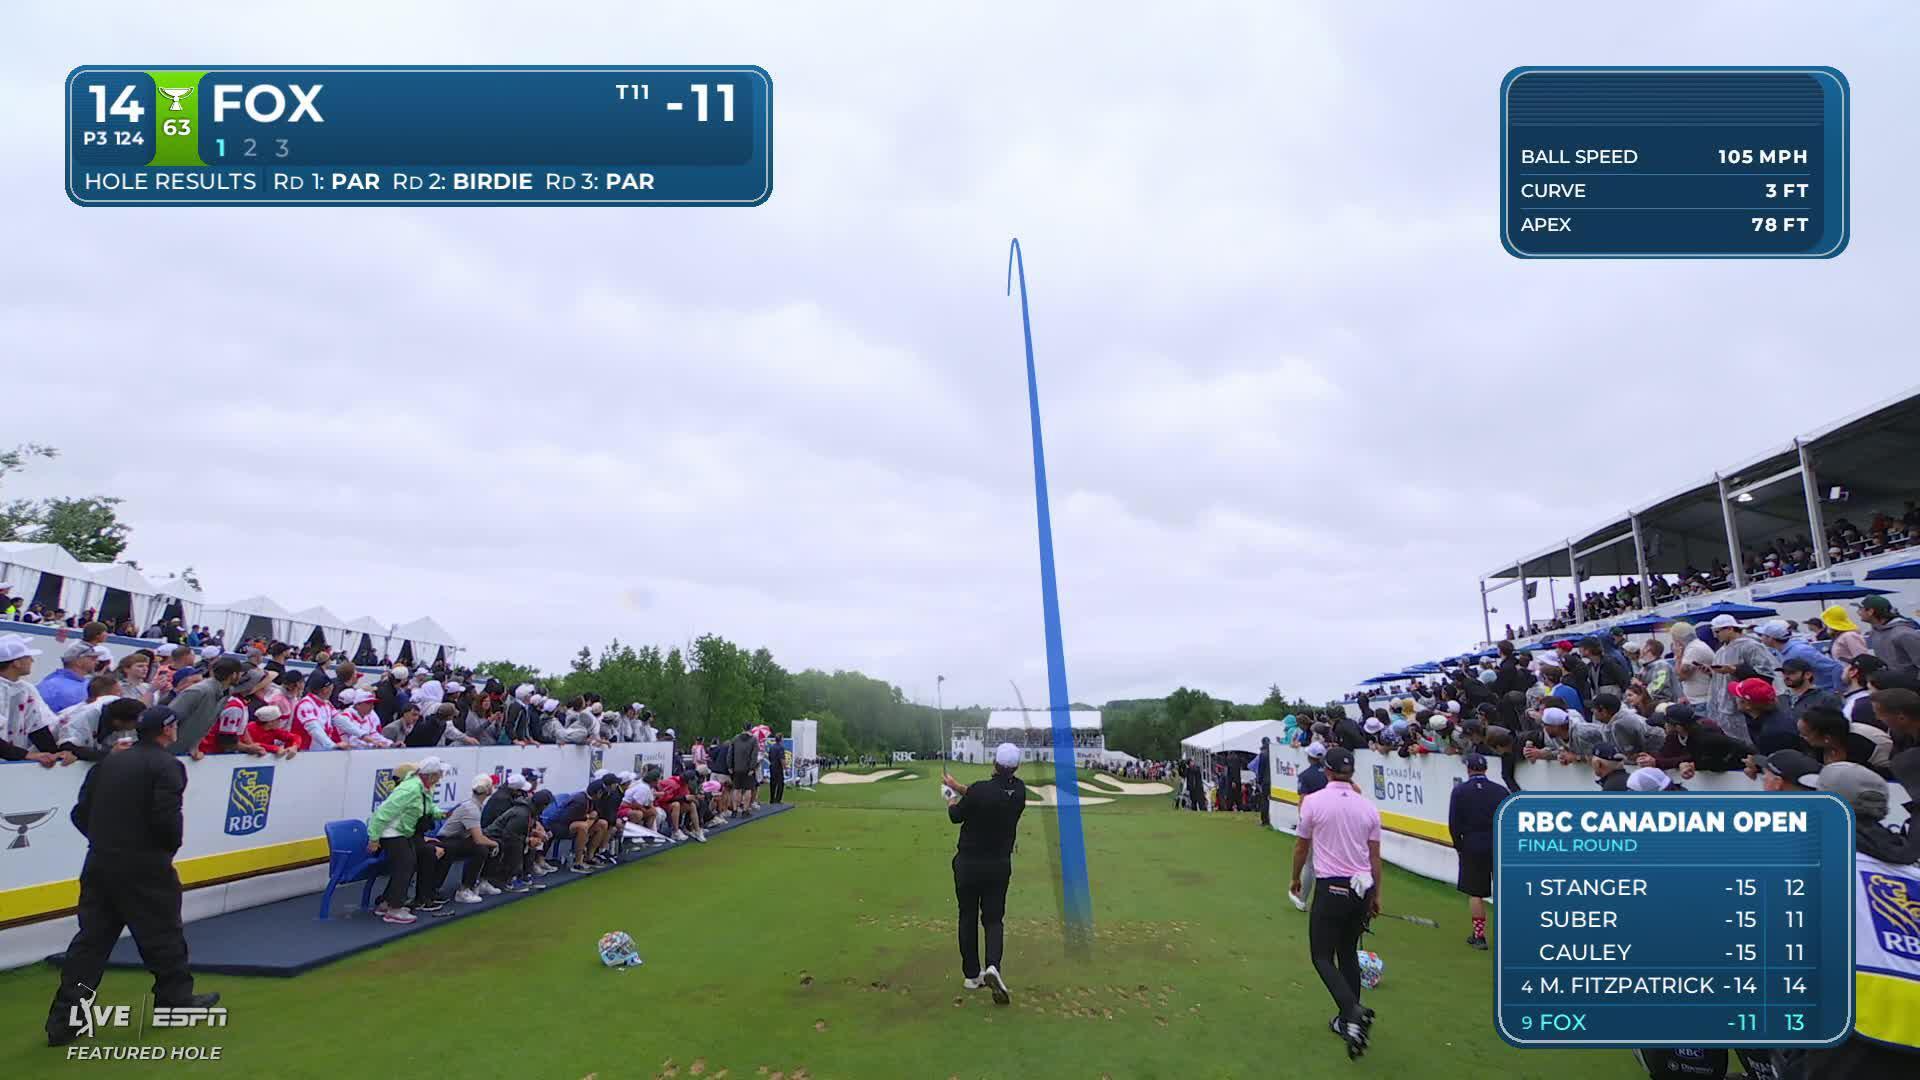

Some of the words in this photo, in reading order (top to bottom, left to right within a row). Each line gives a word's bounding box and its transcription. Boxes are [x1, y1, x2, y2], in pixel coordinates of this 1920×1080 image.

[892, 751, 916, 762] RBC
[1386, 768, 1422, 784] CANADIAN
[1387, 782, 1424, 805] OPEN
[228, 813, 264, 834] RBC
[1883, 931, 1920, 955] RB
